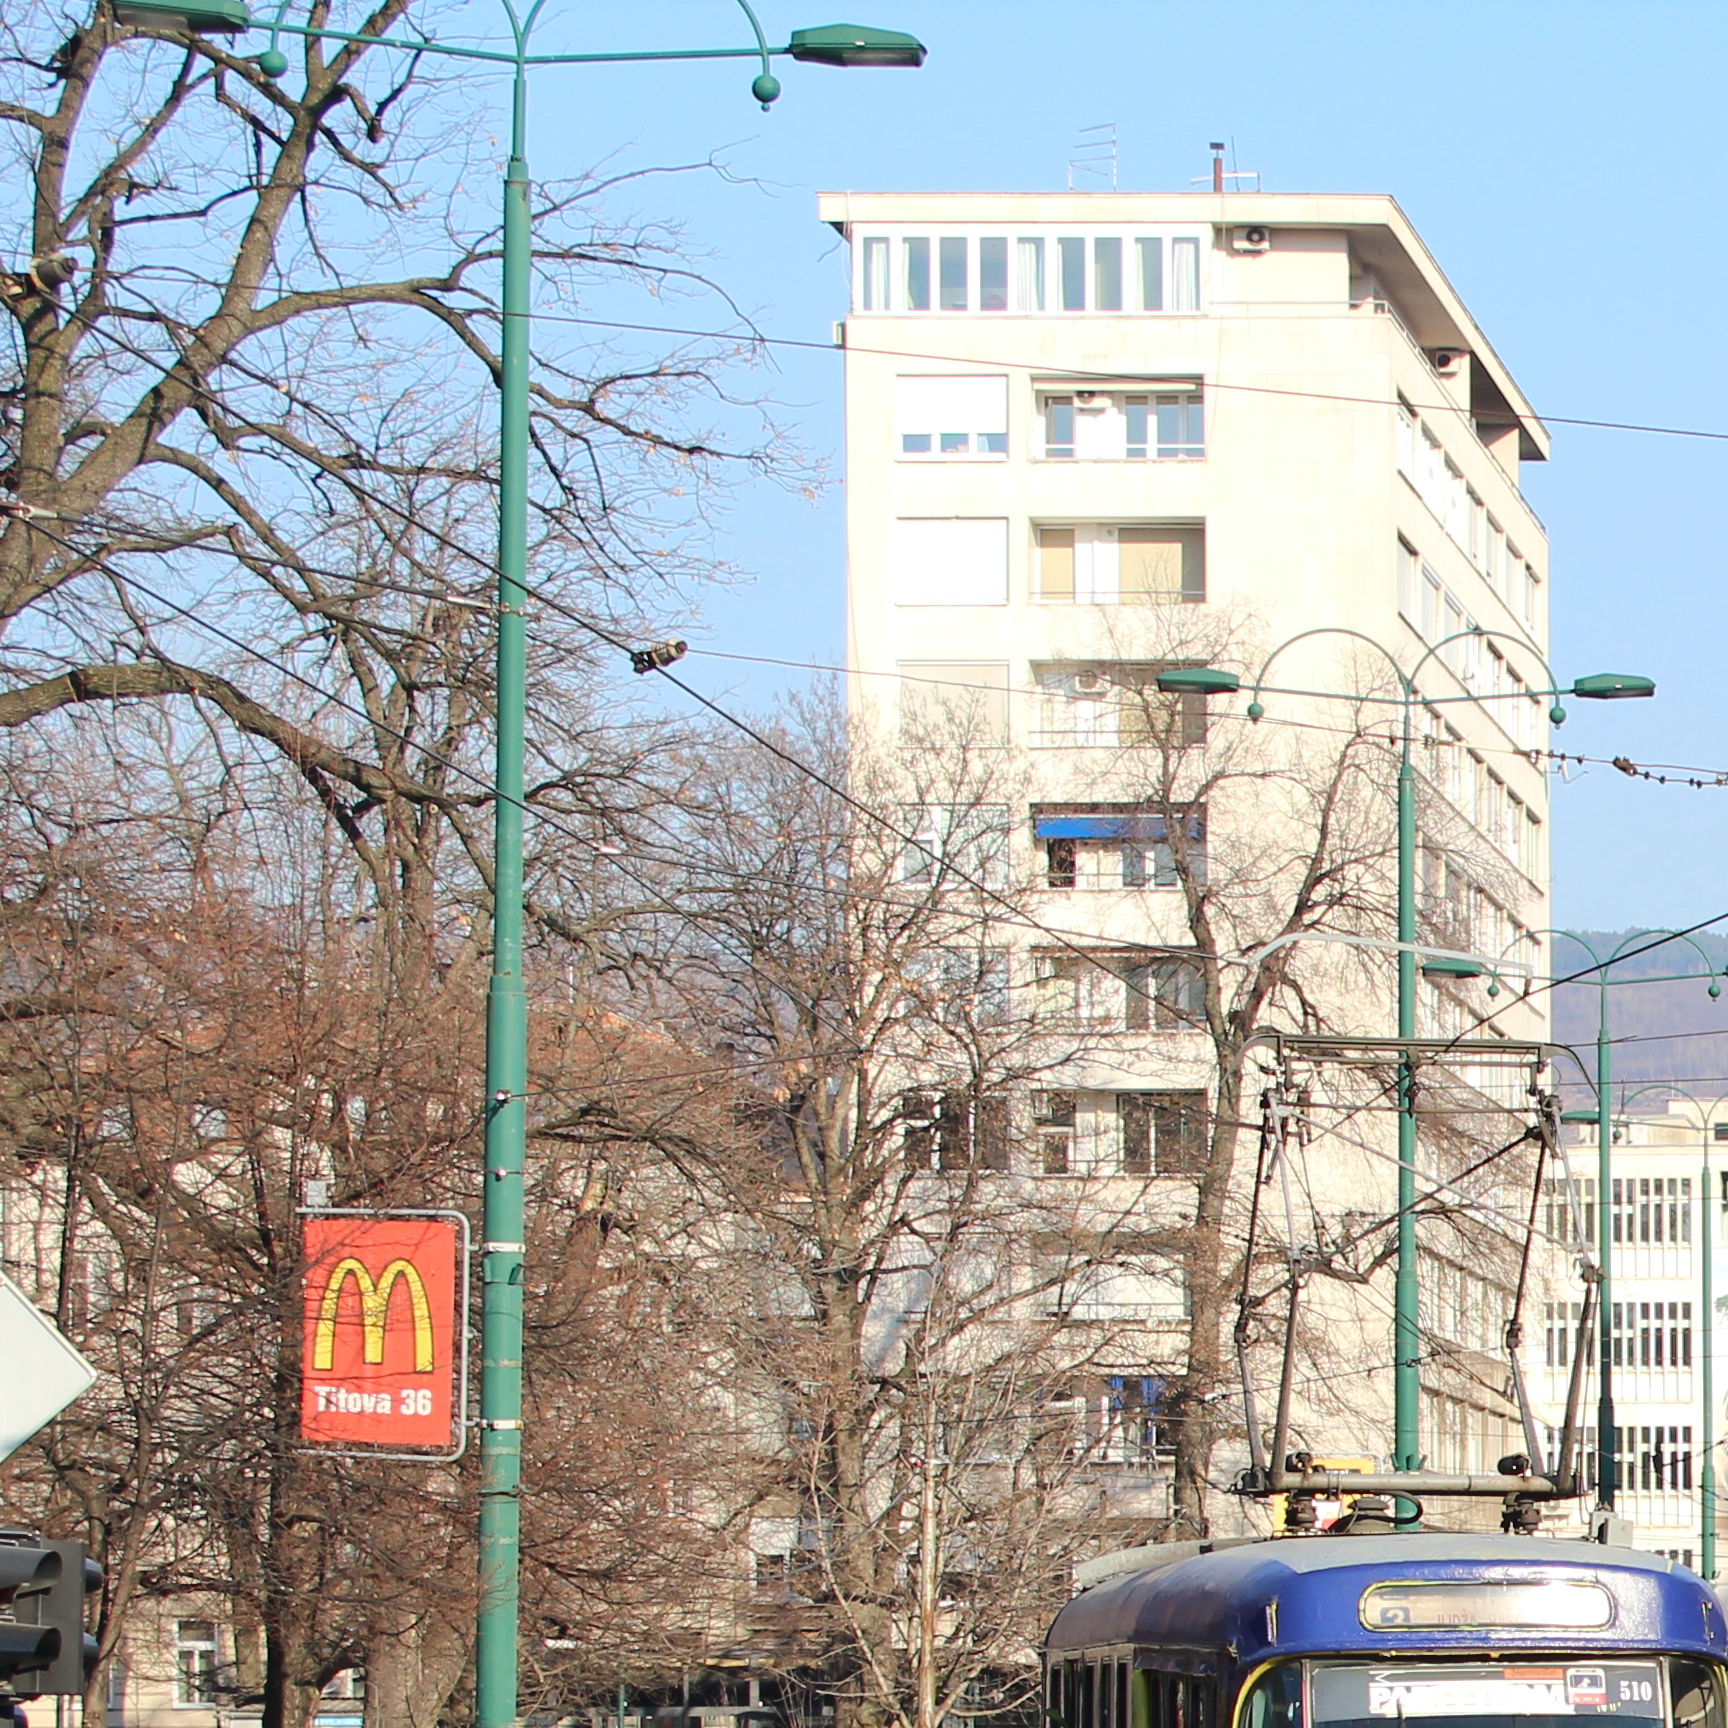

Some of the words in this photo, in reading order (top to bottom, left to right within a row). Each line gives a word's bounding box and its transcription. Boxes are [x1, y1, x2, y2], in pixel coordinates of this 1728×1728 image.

[313, 1385, 393, 1415] Titova
[400, 1388, 433, 1416] 36
[1619, 1680, 1652, 1701] 510
